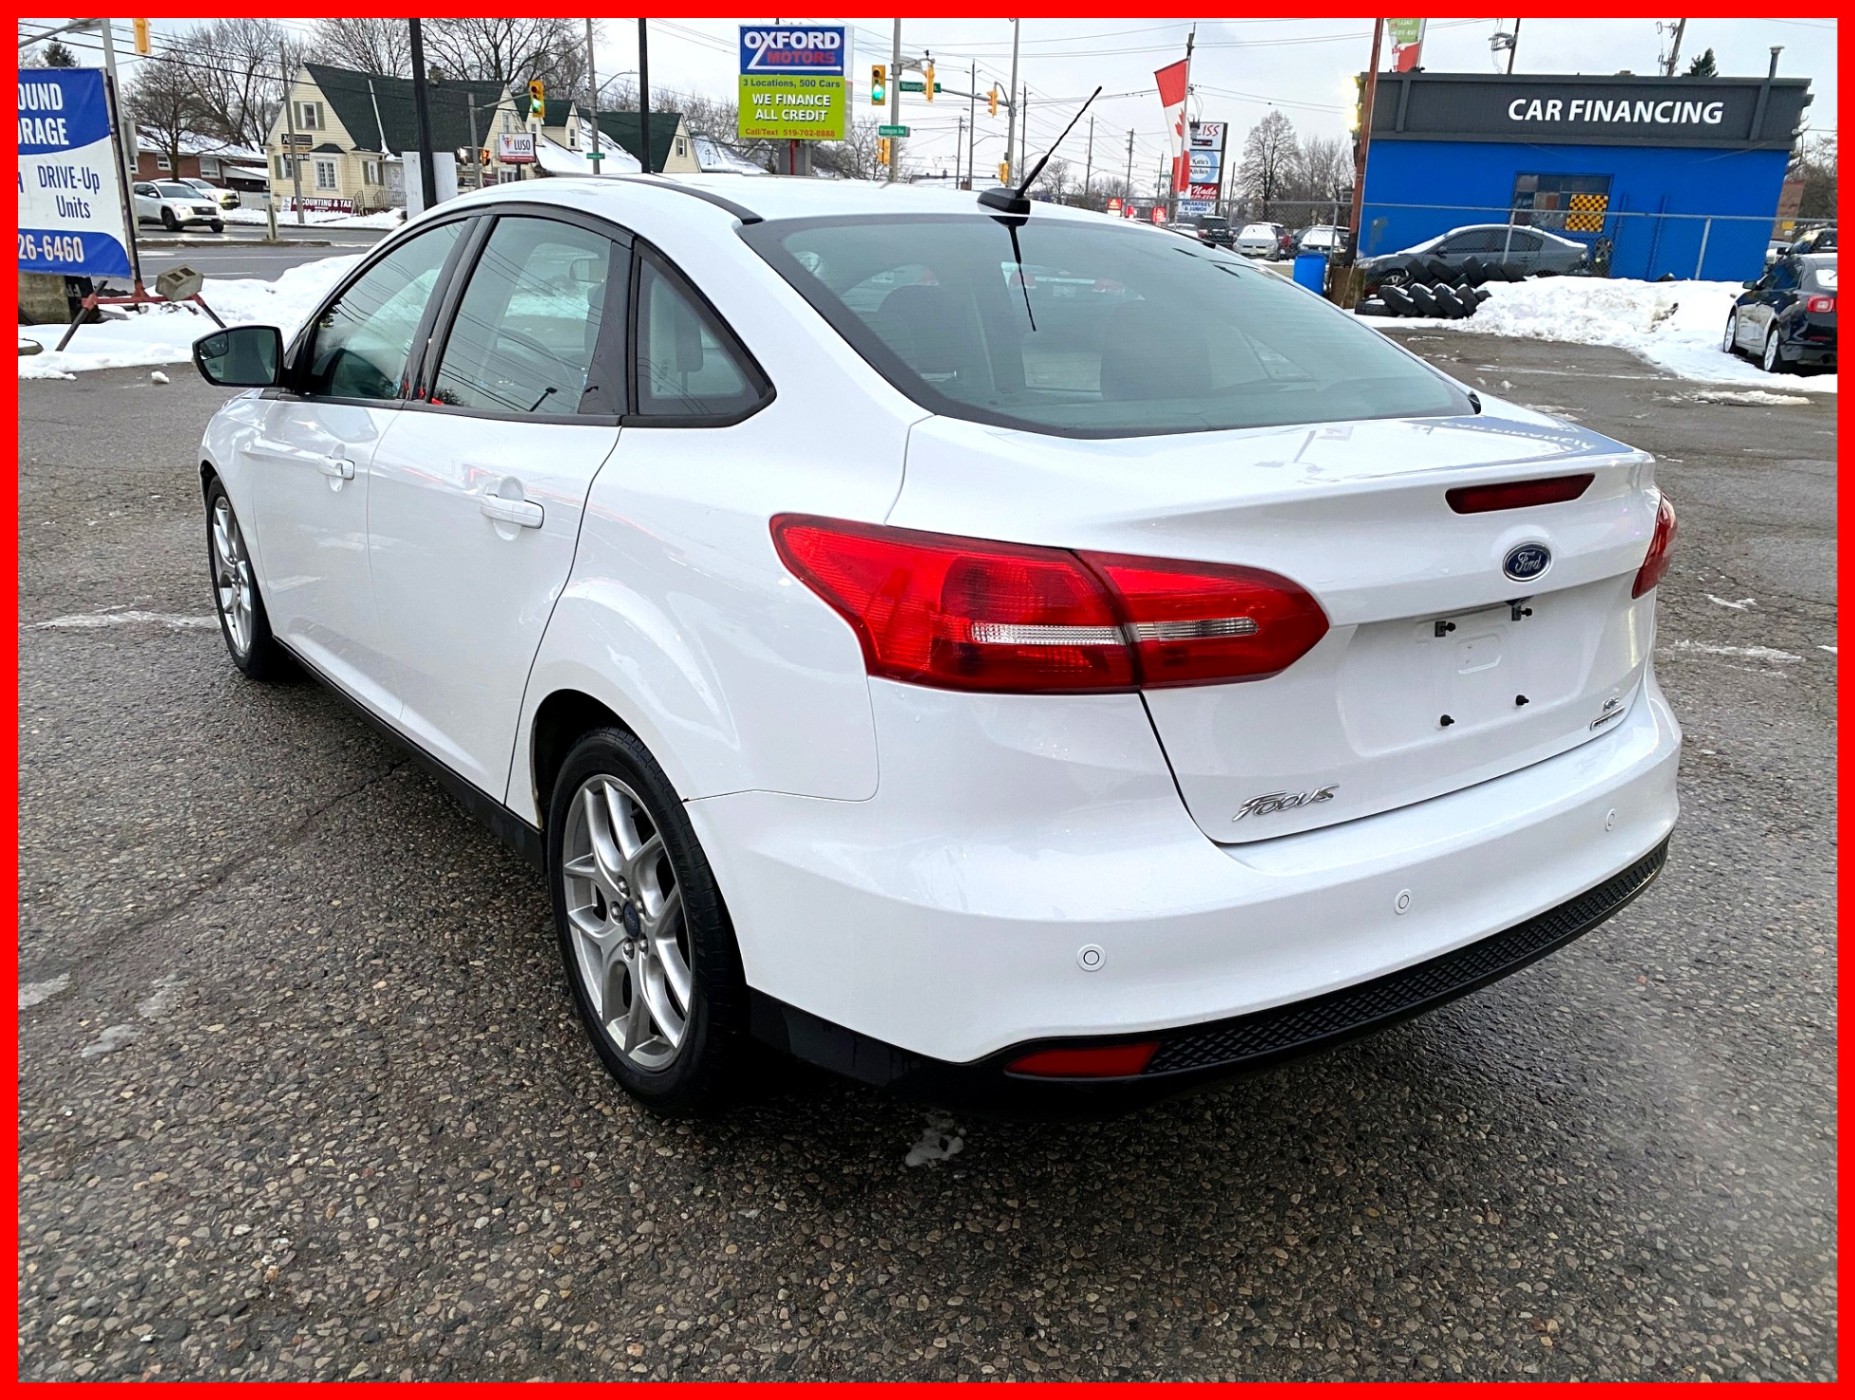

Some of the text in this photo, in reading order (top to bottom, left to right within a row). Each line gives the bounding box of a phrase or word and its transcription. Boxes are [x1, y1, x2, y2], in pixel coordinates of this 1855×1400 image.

[744, 31, 840, 49] OXFORD
[767, 51, 835, 64] MOTORS
[743, 79, 840, 88] 3 Locations, 500 Cars
[752, 94, 831, 107] WE FINANCE
[755, 109, 828, 122] ALL CREDIT
[1508, 99, 1724, 124] CAR FINANCING
[514, 139, 531, 151] LUSO
[37, 165, 100, 194] DRIVE-Up
[1192, 186, 1217, 195] Nails
[56, 195, 91, 219] Units
[292, 198, 332, 208] ACOUNTING
[340, 200, 352, 208] TAX
[1515, 551, 1542, 573] Ford
